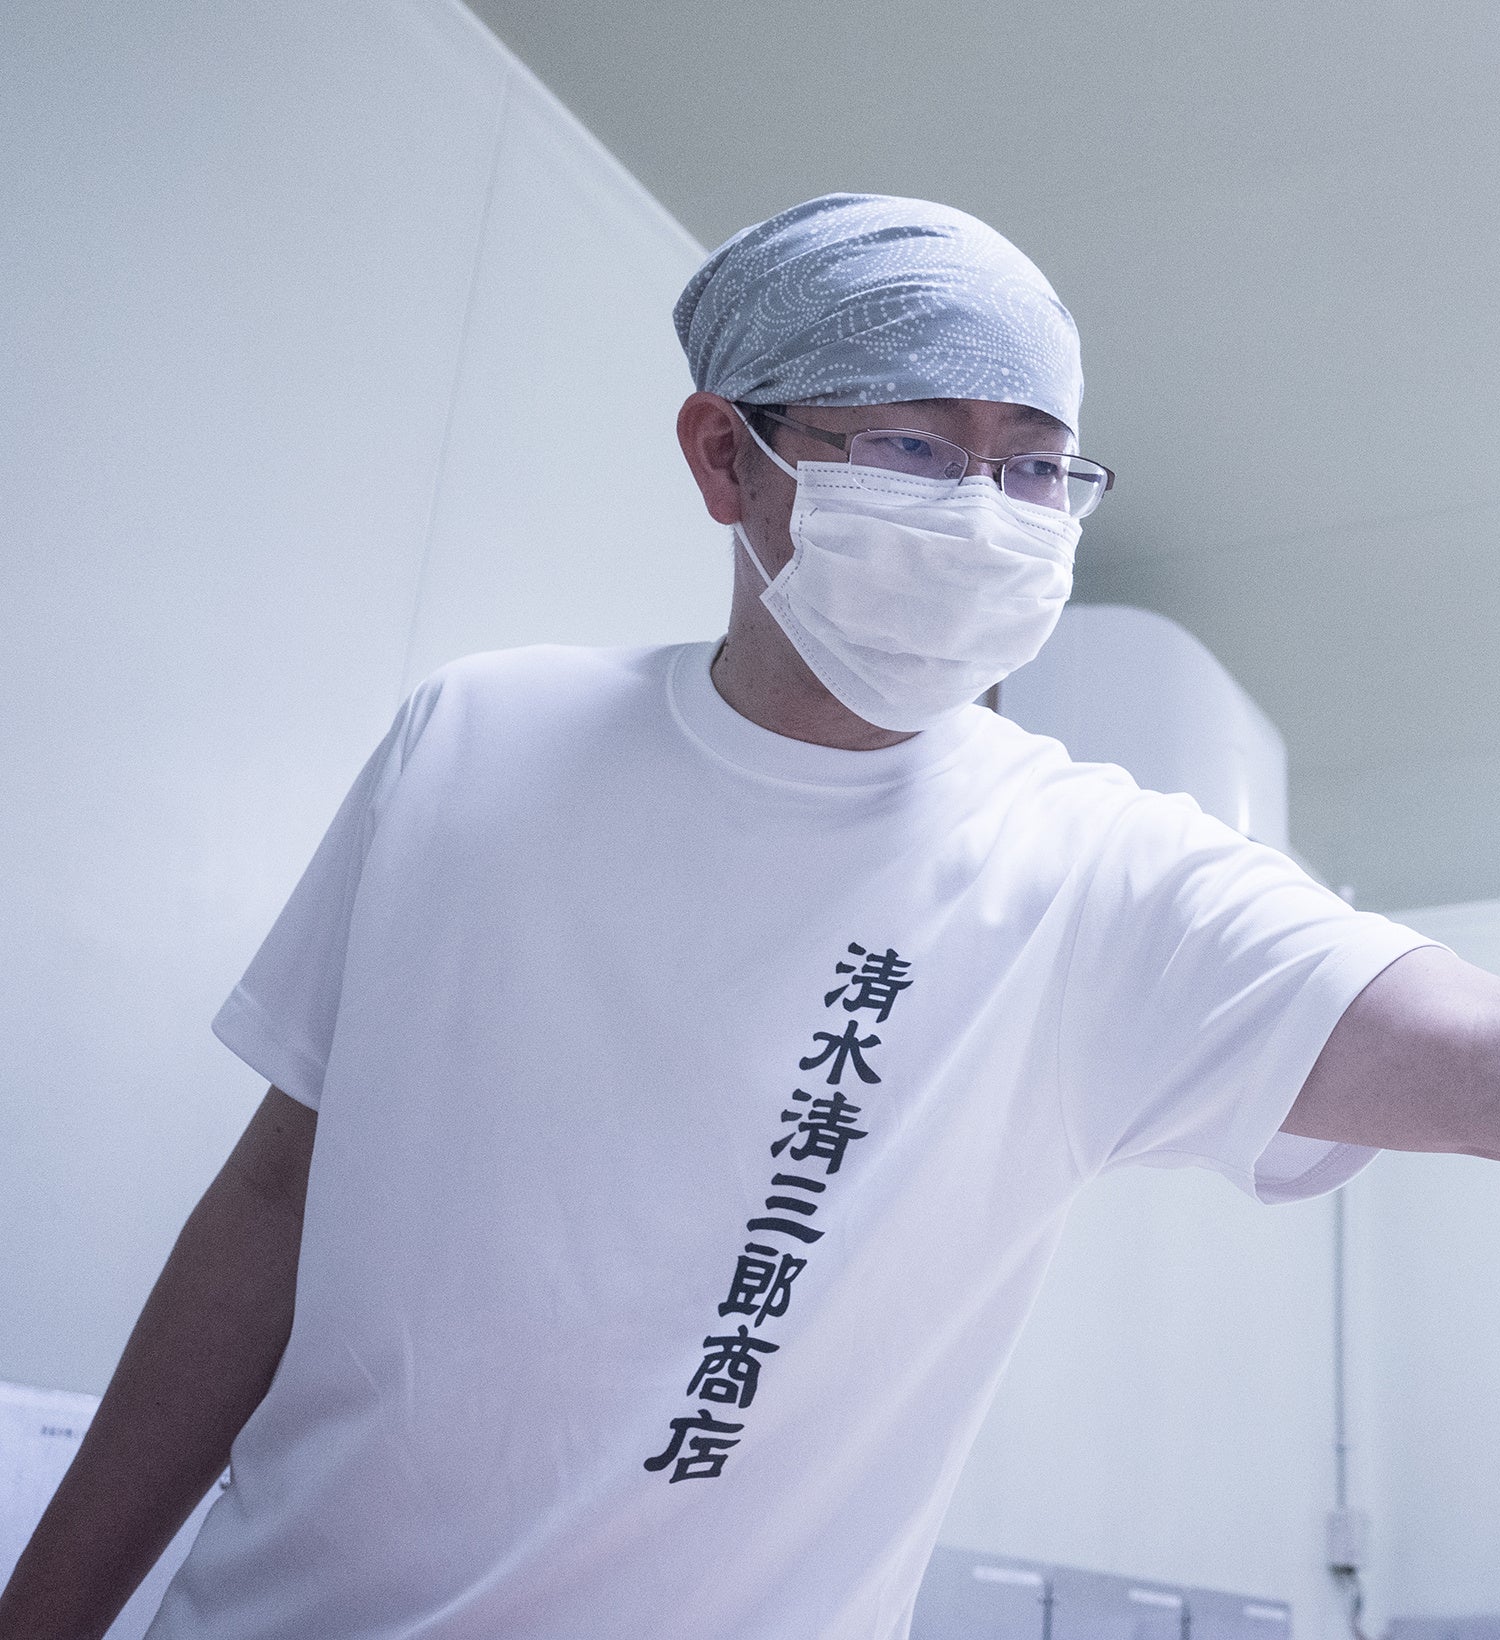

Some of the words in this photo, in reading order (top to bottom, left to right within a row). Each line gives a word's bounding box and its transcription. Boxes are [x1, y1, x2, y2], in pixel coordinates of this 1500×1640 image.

[643, 941, 914, 1484] 清水清三郎商店
